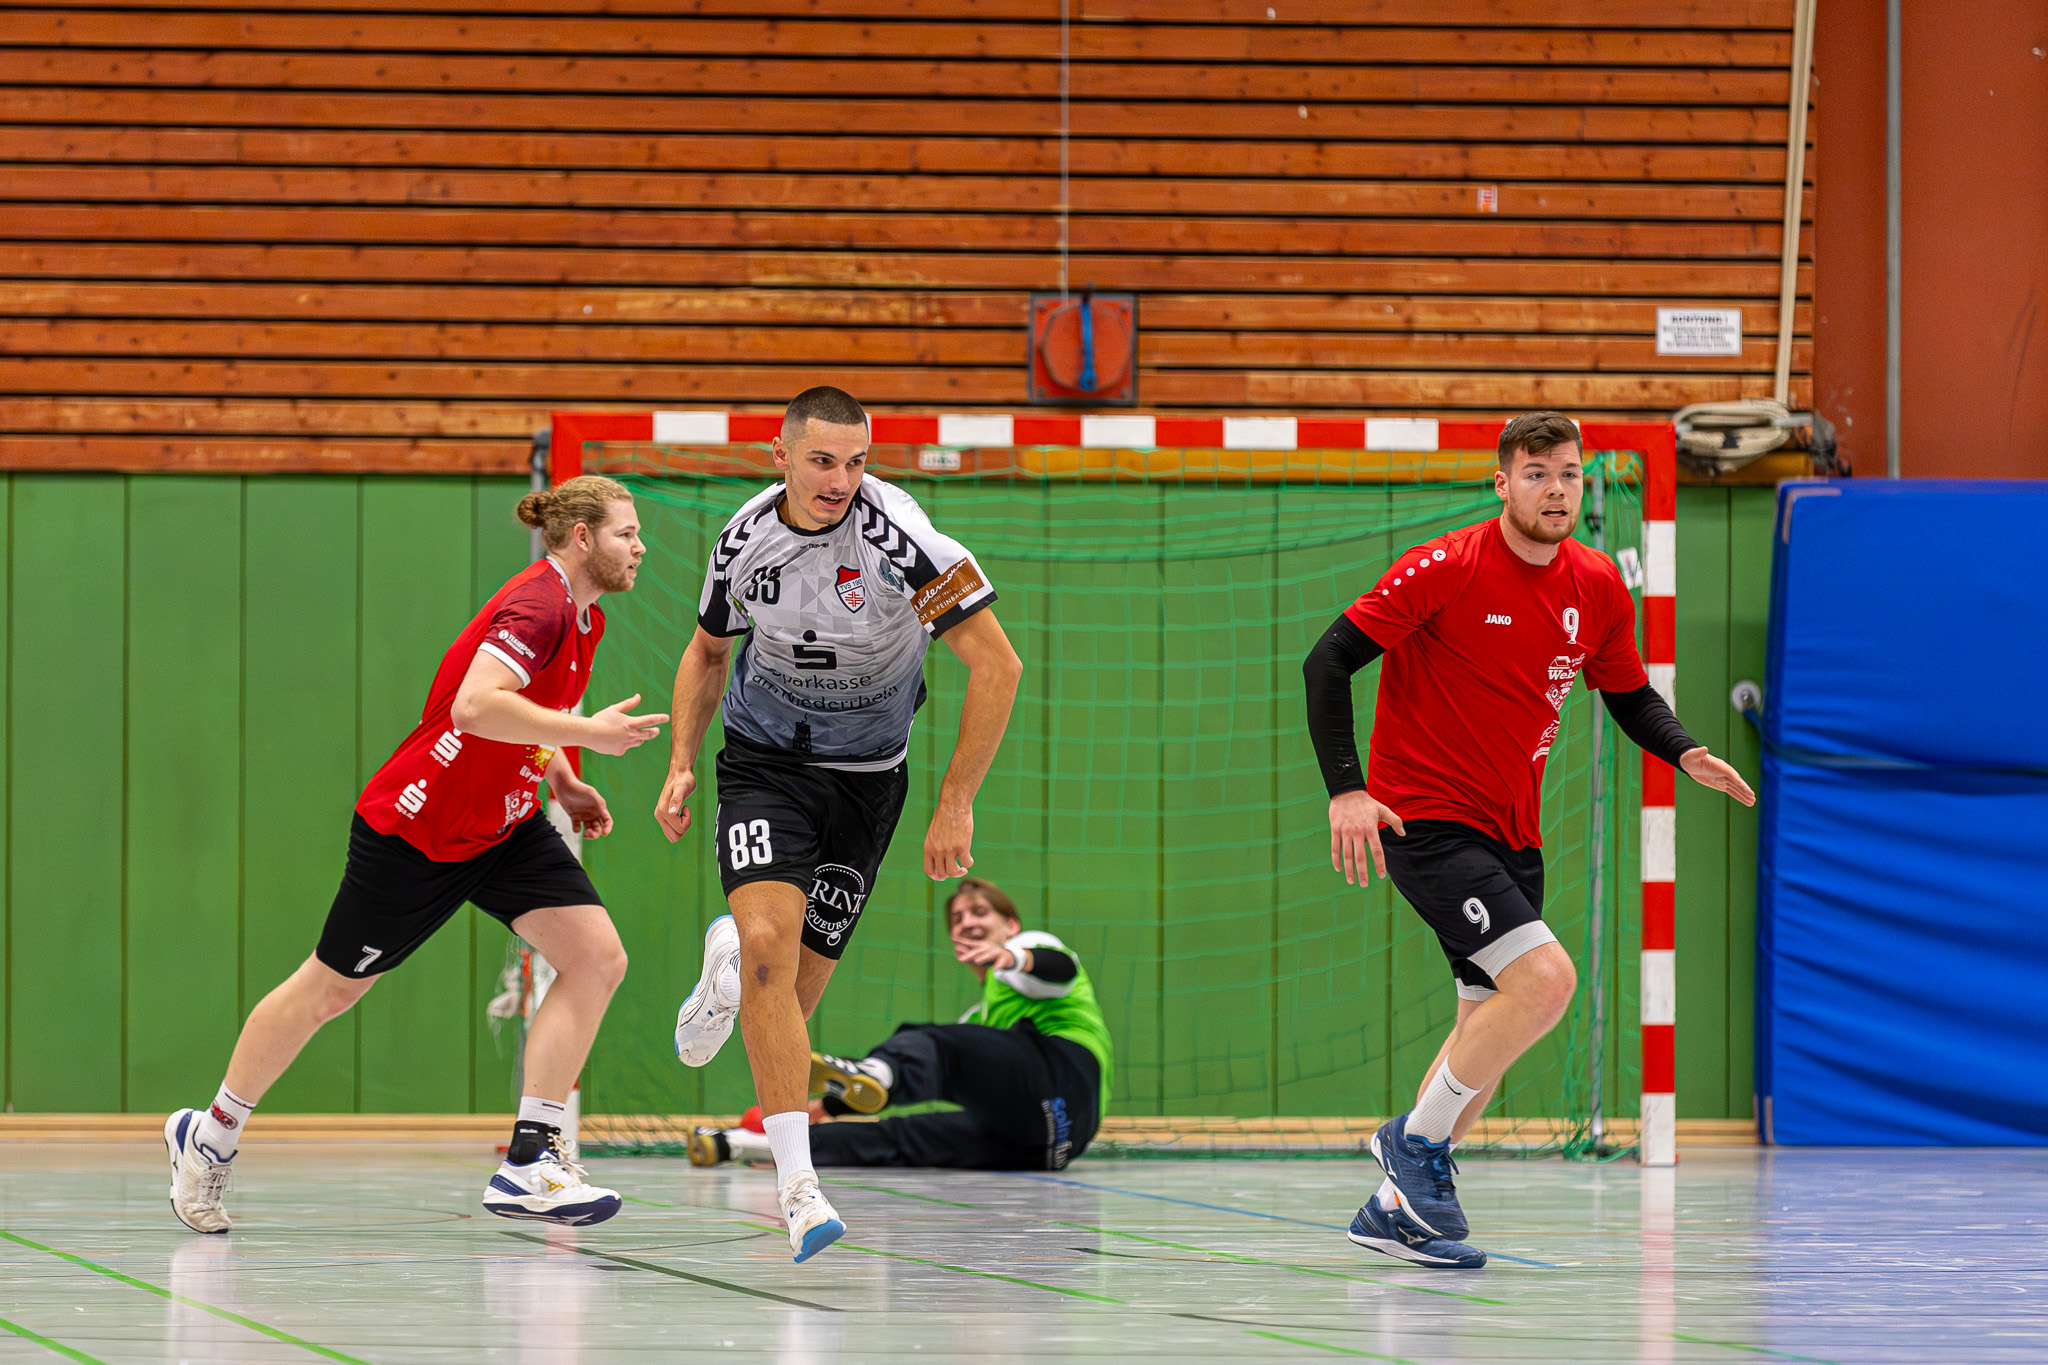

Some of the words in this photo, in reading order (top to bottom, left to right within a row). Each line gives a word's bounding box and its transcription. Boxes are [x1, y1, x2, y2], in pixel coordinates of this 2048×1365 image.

[1485, 613, 1512, 626] JAKO
[1562, 607, 1580, 645] 9
[728, 818, 773, 871] 83
[806, 899, 849, 931] LIQUEURS
[1462, 897, 1491, 935] 9
[353, 945, 383, 973] 7
